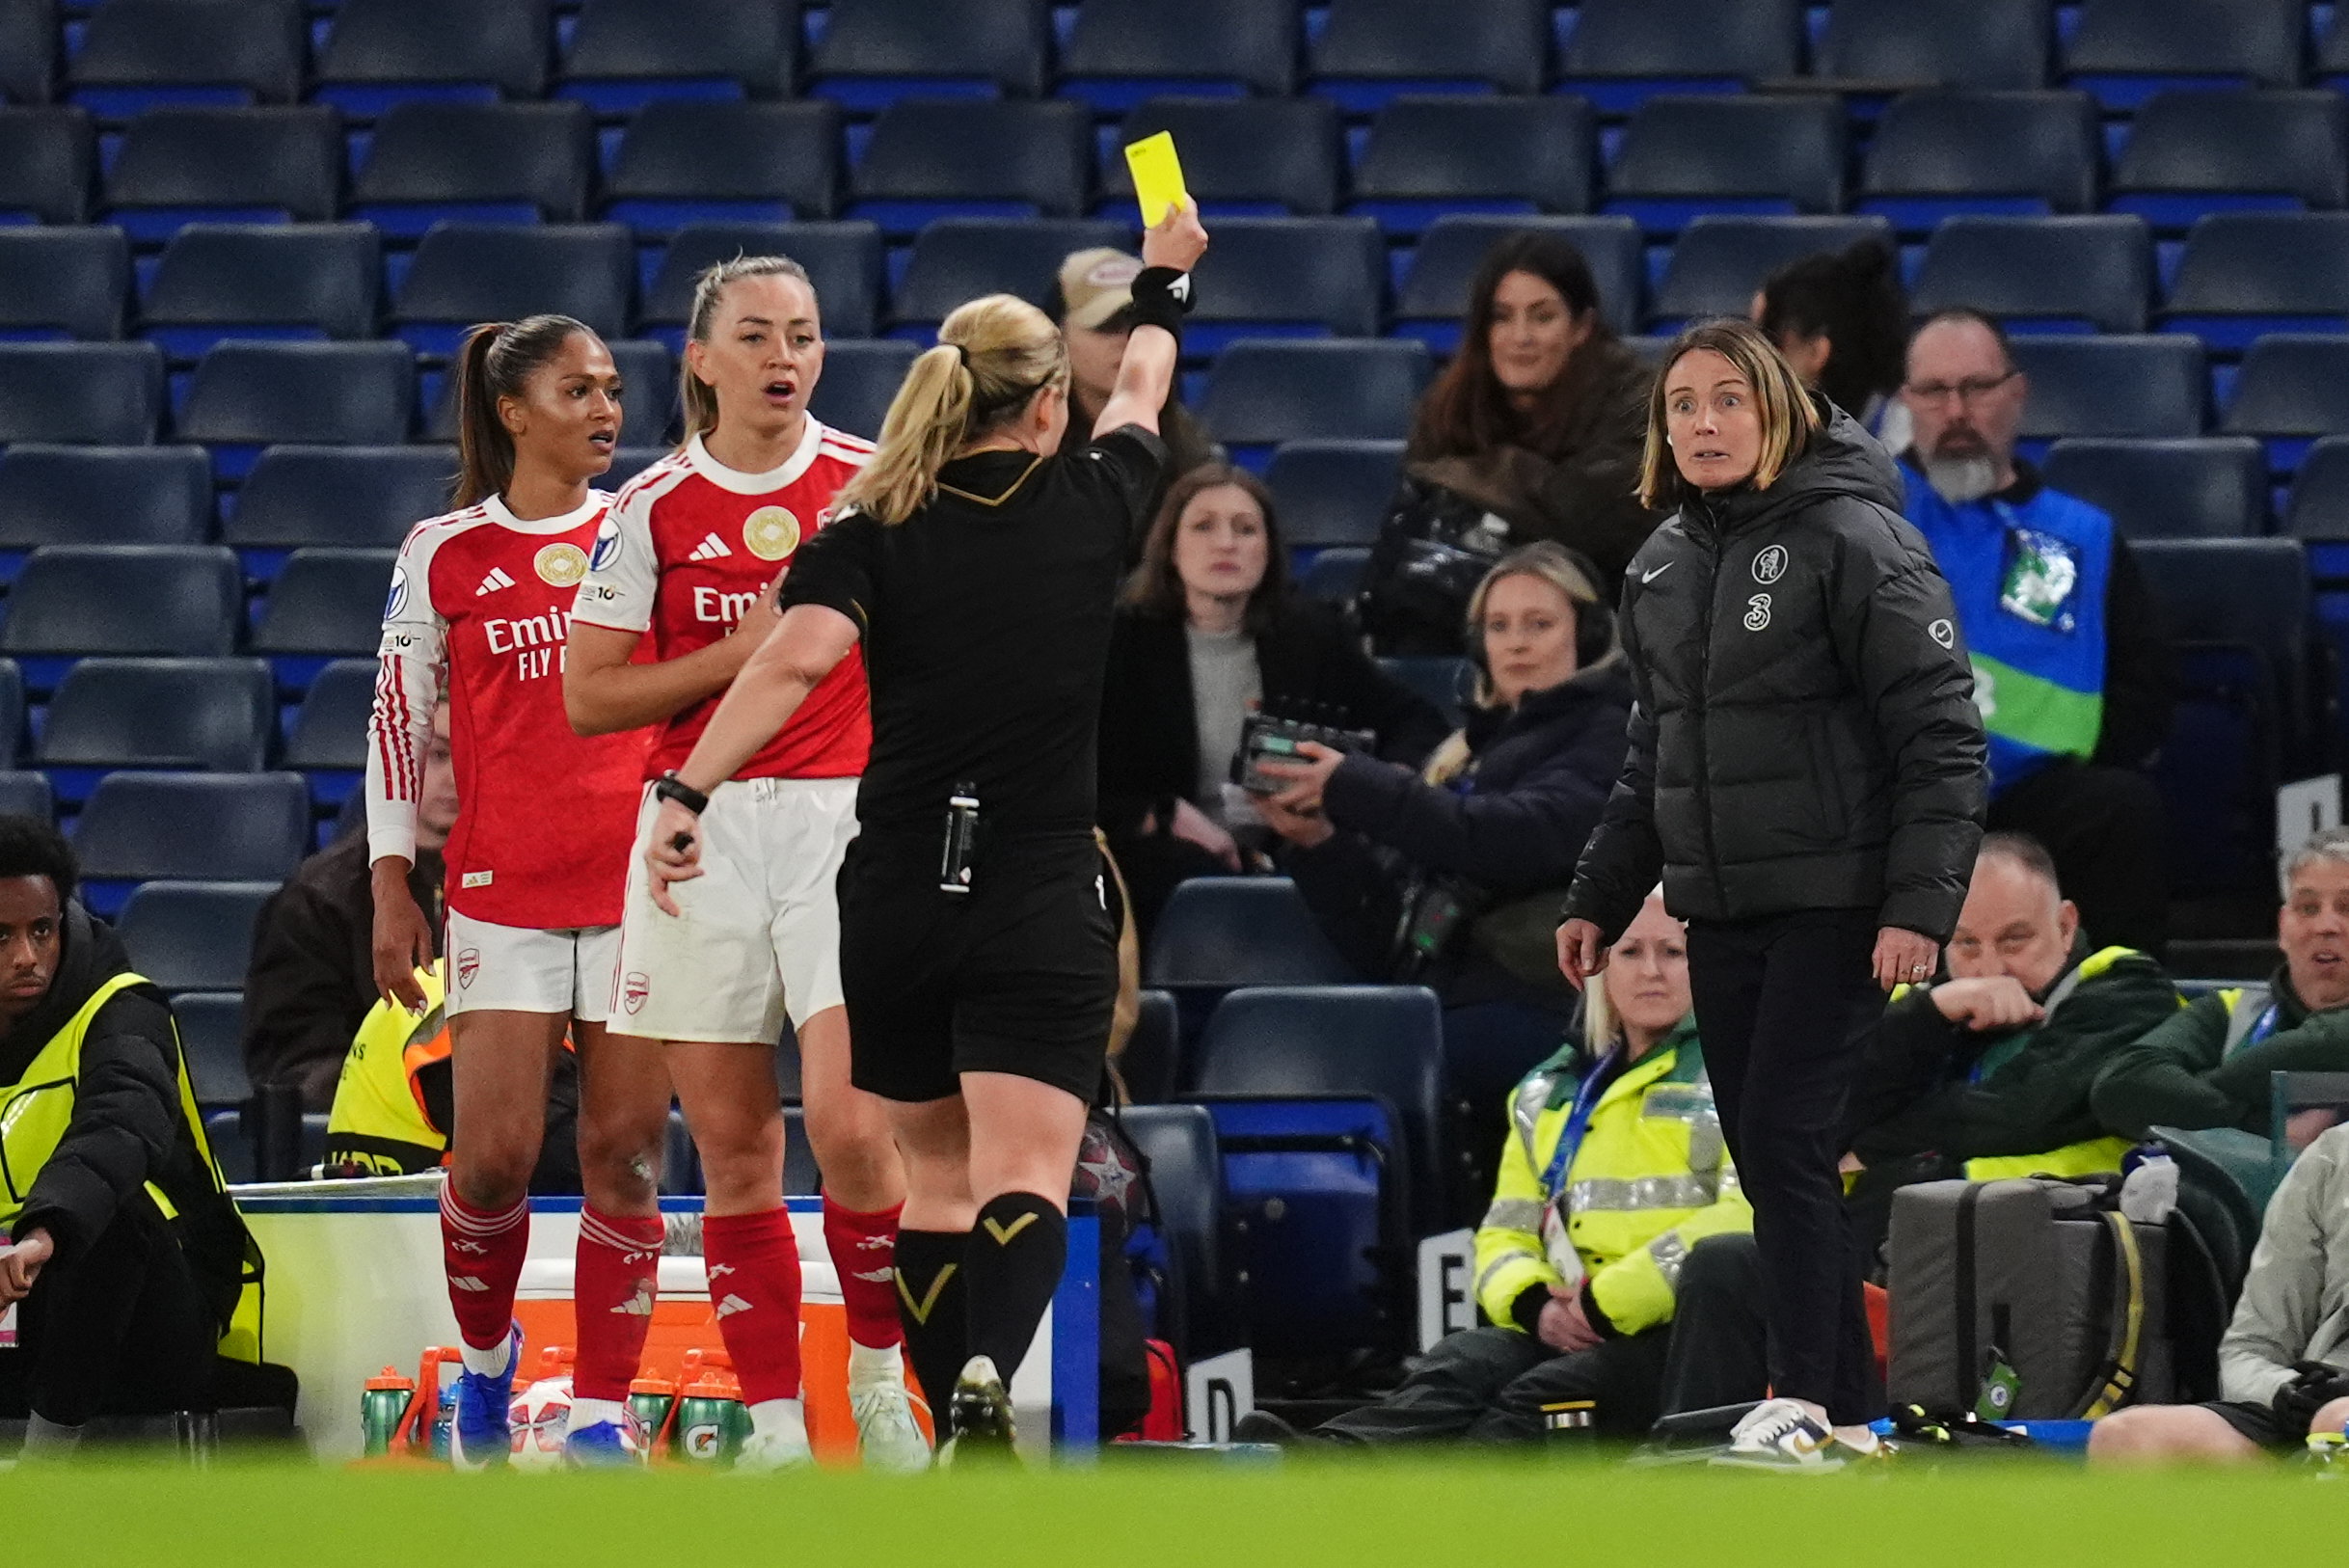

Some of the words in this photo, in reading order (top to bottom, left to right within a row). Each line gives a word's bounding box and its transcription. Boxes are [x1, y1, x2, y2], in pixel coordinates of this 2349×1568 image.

[1743, 593, 1771, 631] 3
[518, 647, 552, 682] FLY
[686, 1424, 718, 1458] G
